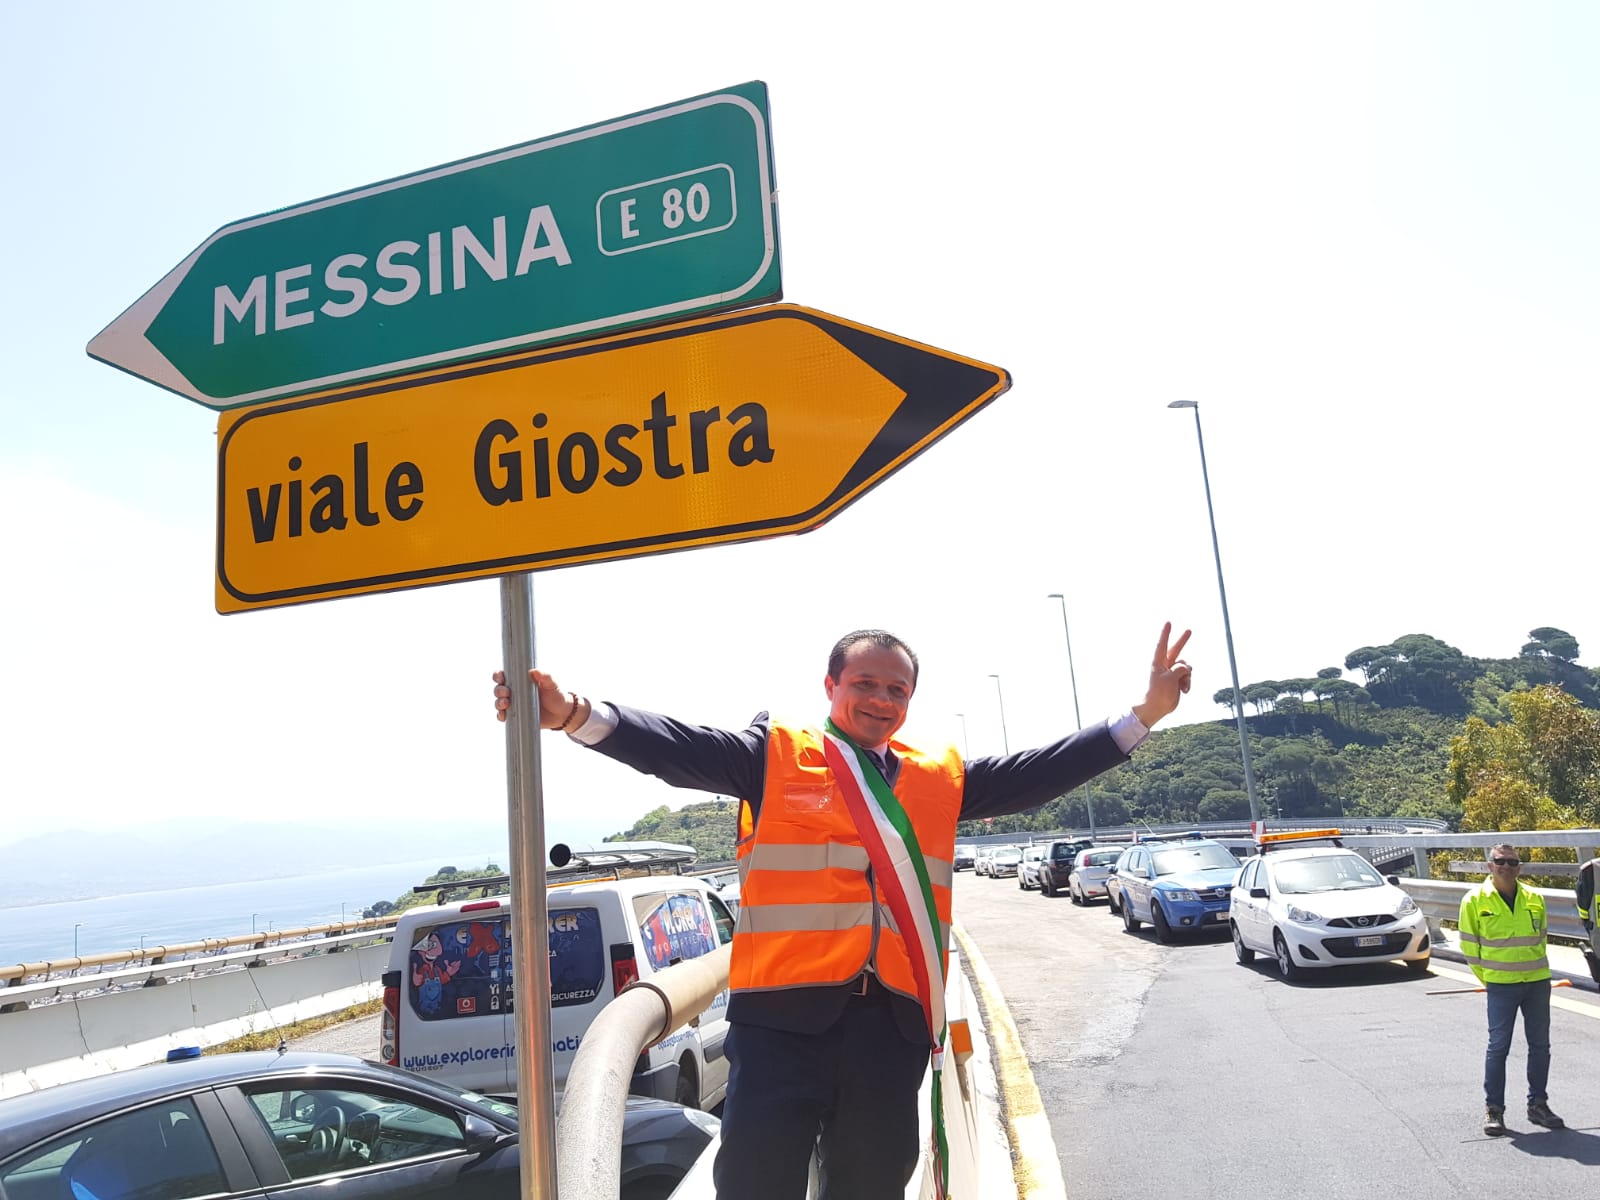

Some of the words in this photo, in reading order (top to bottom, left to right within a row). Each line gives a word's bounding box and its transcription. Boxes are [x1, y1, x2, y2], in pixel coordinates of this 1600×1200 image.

[620, 198, 640, 239] E
[662, 183, 711, 229] 80
[214, 204, 571, 344] MESSINA
[246, 441, 424, 543] viale
[474, 392, 774, 506] Giostra
[551, 989, 596, 1001] SICUREZZA
